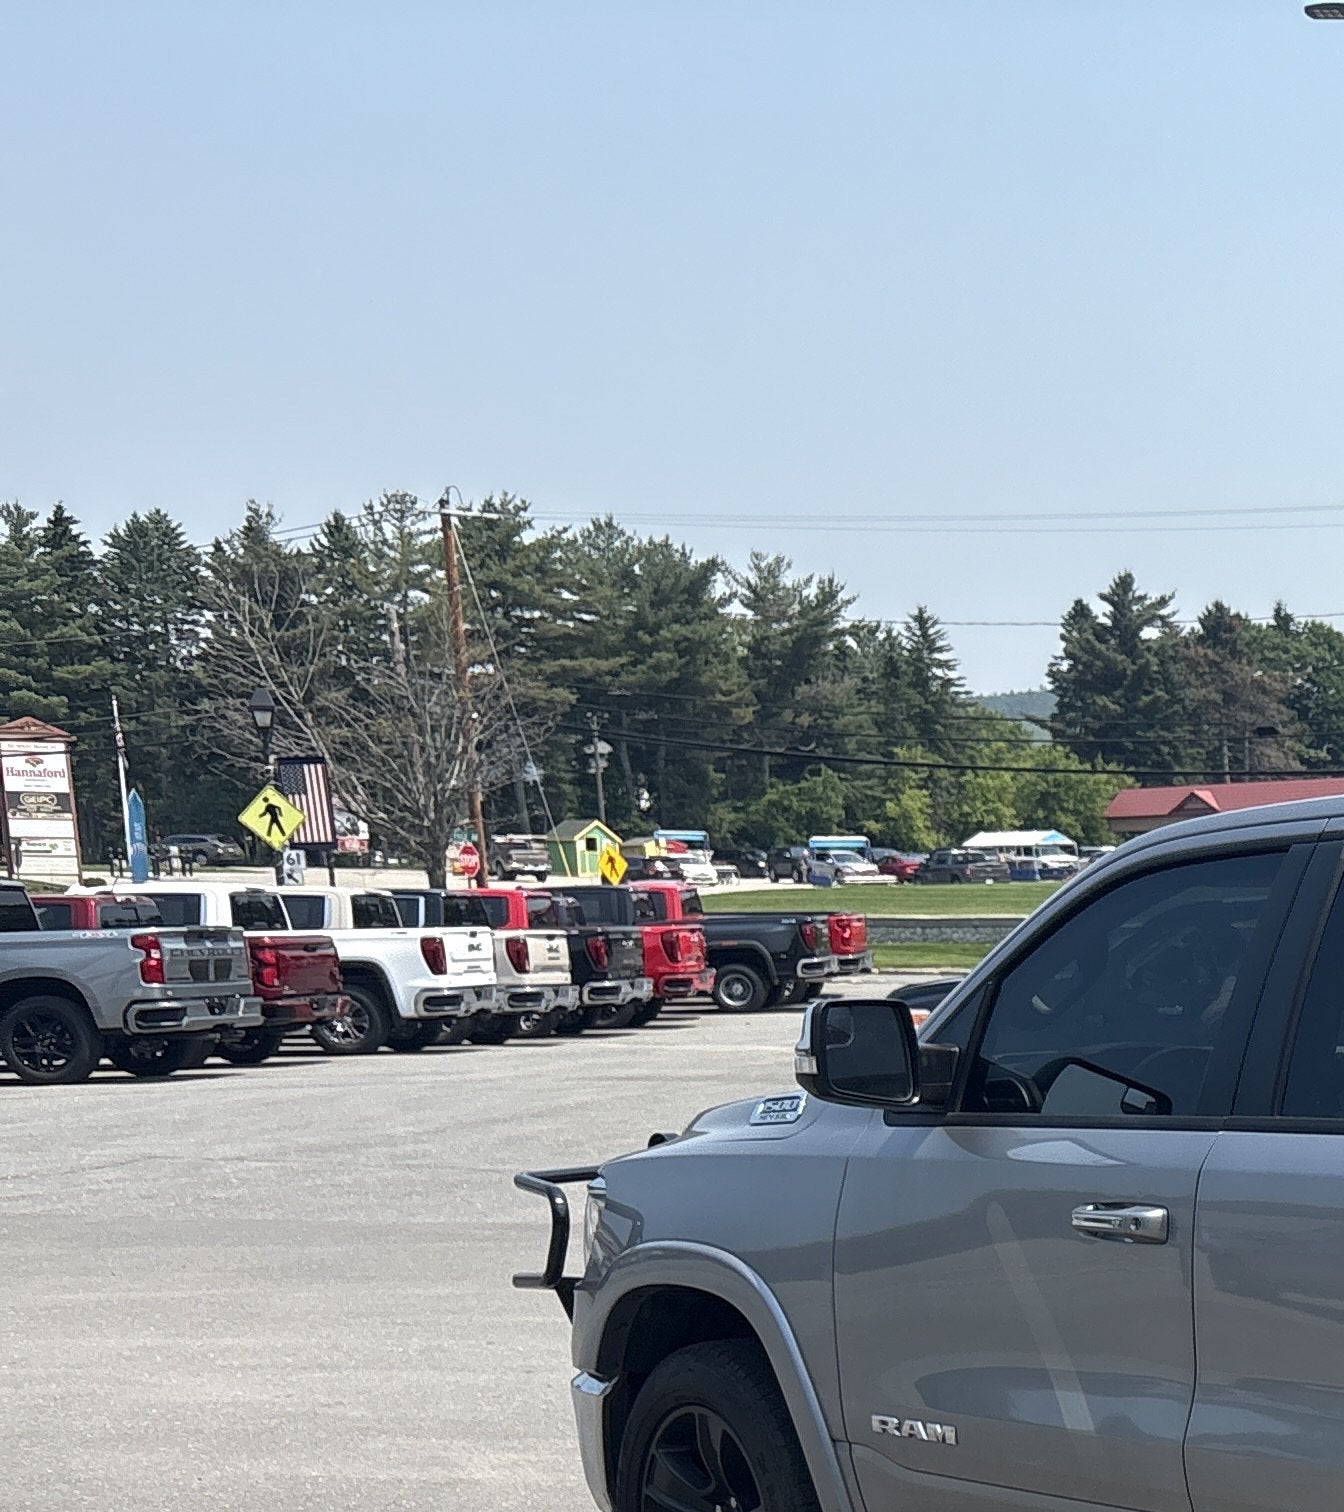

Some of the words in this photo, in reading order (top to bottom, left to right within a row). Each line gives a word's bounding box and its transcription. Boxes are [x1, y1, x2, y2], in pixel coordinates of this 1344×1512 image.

[6, 766, 66, 779] Hannaford
[286, 853, 301, 866] 61
[871, 1414, 957, 1446] RAM
